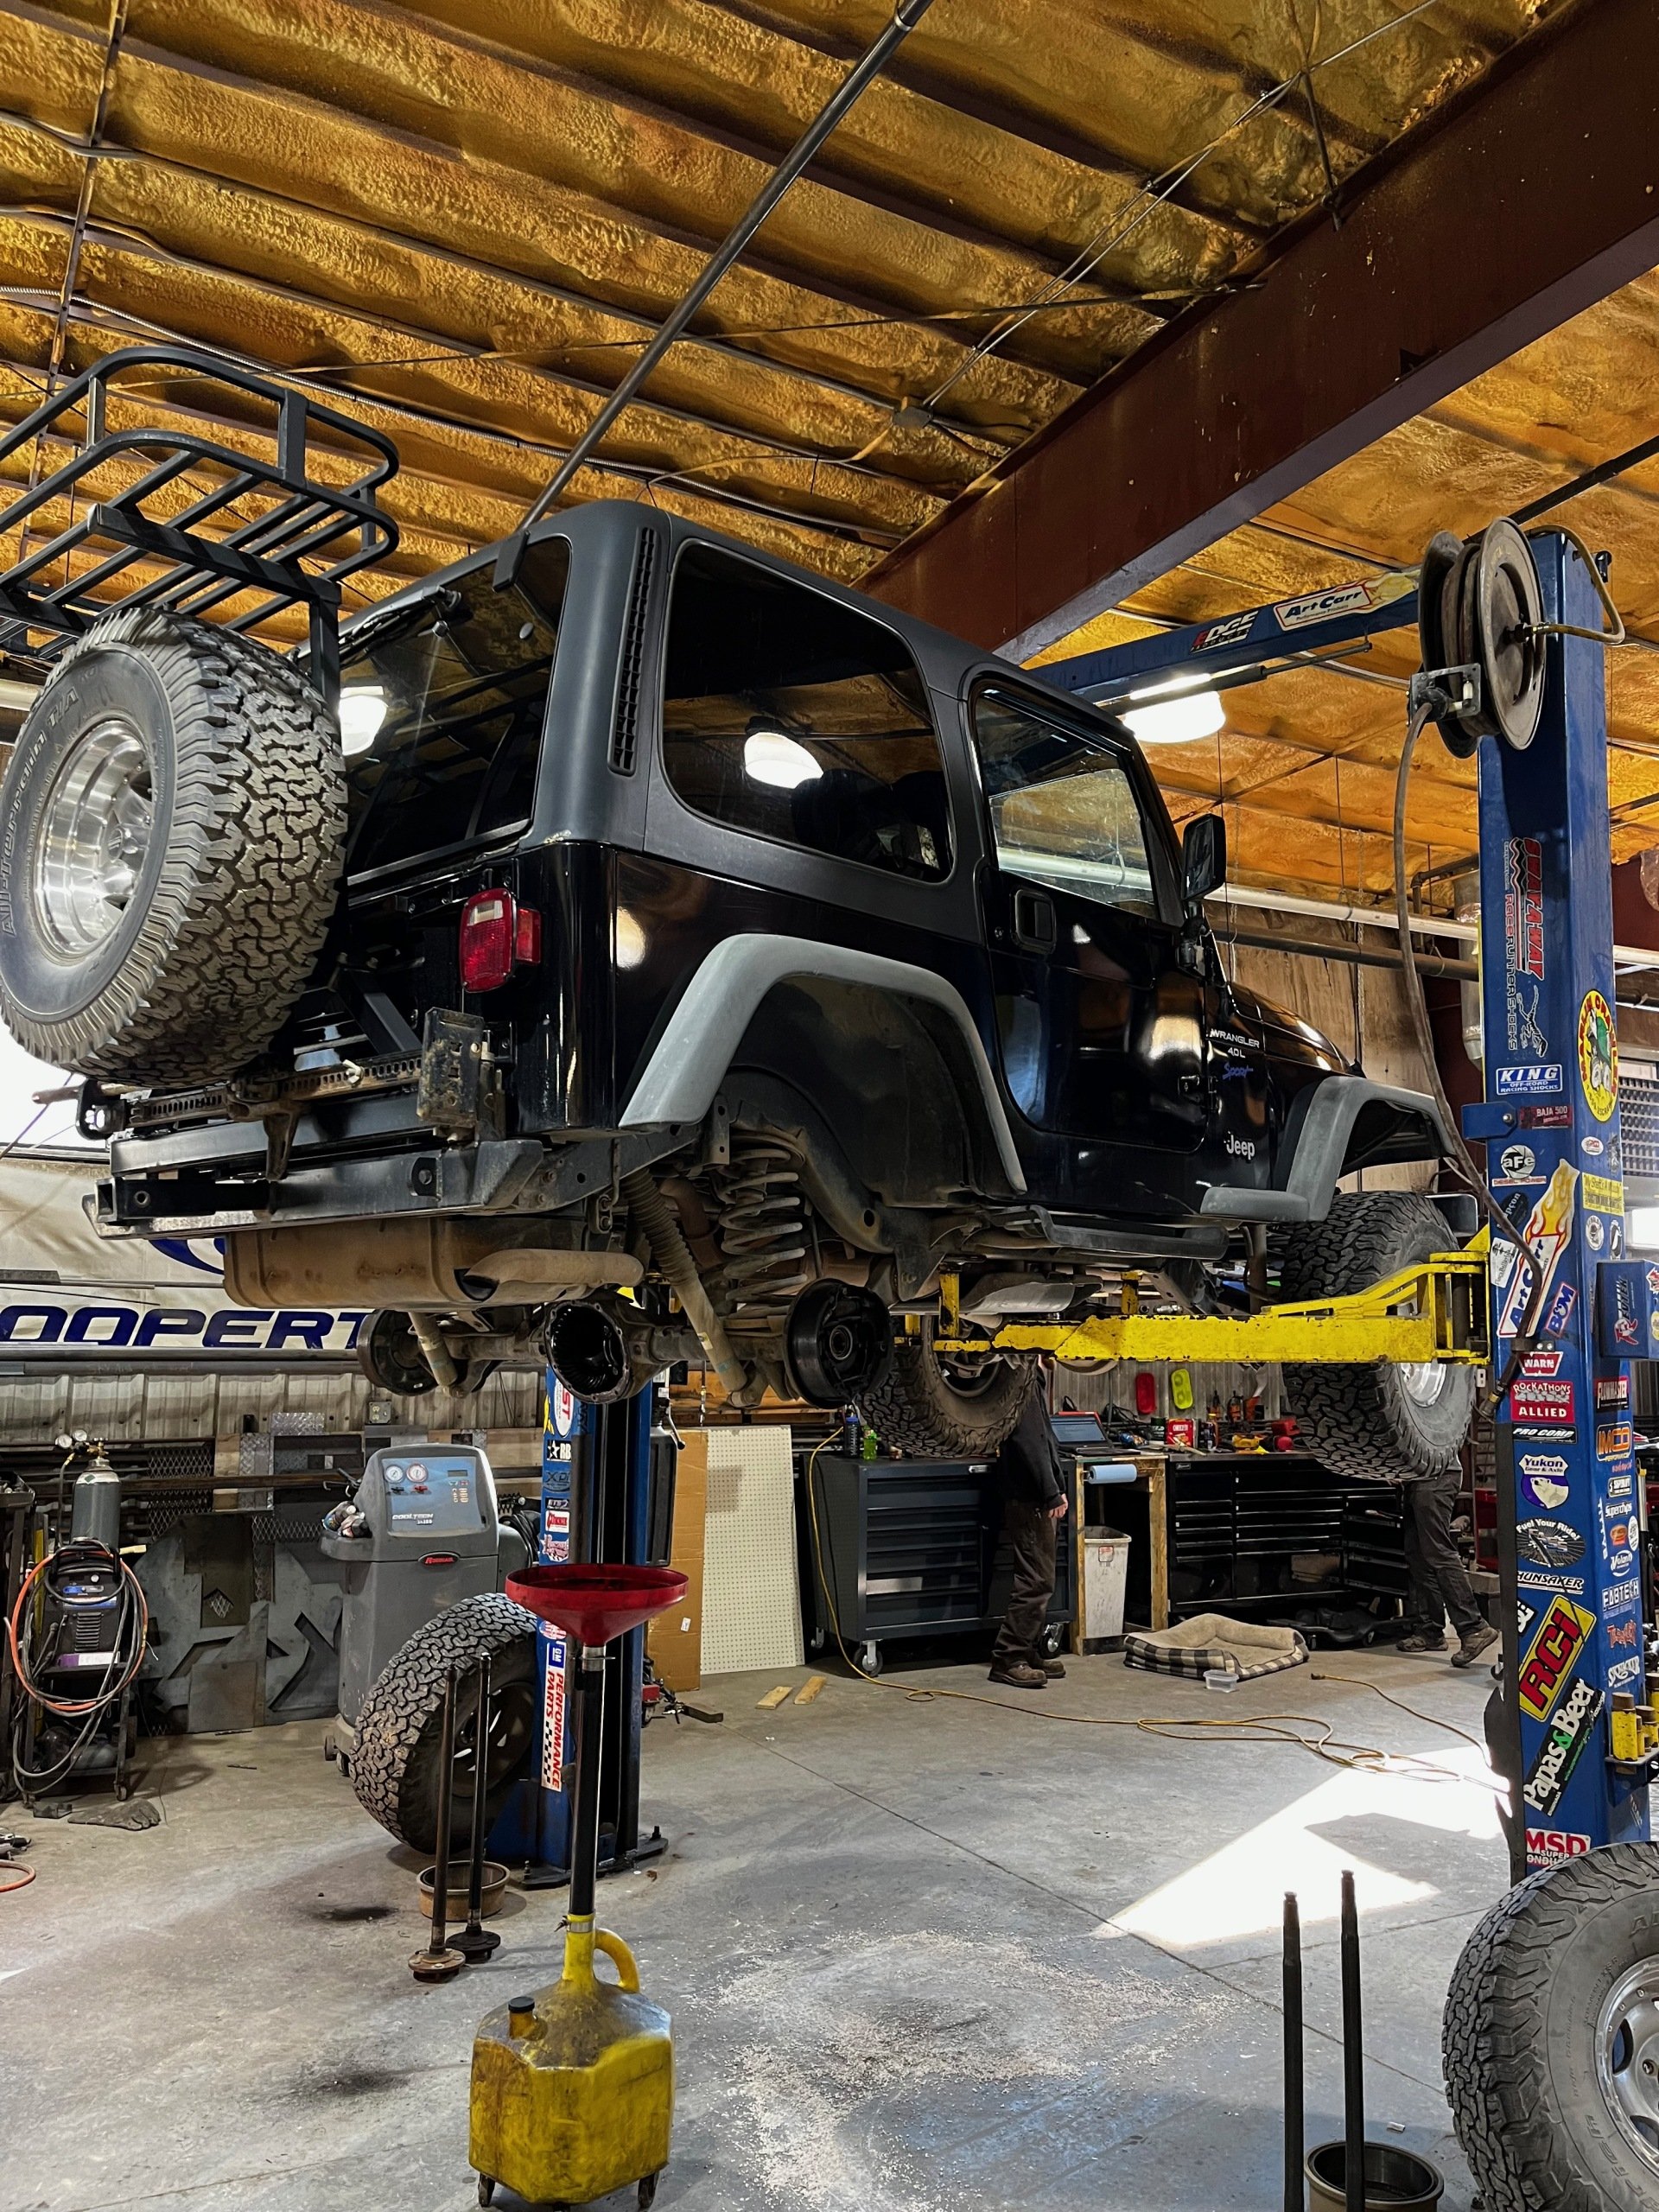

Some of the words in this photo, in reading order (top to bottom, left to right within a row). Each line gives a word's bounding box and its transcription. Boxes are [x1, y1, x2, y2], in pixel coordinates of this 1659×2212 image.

[1210, 1028, 1261, 1048] WRANGLER
[1223, 1062, 1254, 1080] Sport
[1500, 1067, 1559, 1082] KING
[1536, 1107, 1554, 1116] BAJA
[1554, 1106, 1568, 1115] 500
[1226, 1134, 1255, 1160] Jeep
[1503, 1156, 1535, 1168] aFe
[1547, 1285, 1574, 1331] B&M
[1524, 1358, 1554, 1369] WARN
[1512, 1382, 1572, 1395] ROCKATHONS
[1518, 1406, 1567, 1418] ALLIED
[1512, 1427, 1537, 1436] PRO
[1537, 1429, 1575, 1439] COMP
[1524, 1458, 1564, 1468] Yukon
[1516, 1519, 1535, 1533] Fuel
[1535, 1518, 1556, 1528] Your
[1557, 1522, 1581, 1541] Ride!
[554, 1648, 563, 1662] GM
[545, 1670, 556, 1719] PARTS
[552, 1672, 565, 1790] PERFORMANCE
[1523, 1741, 1567, 1812] Papas
[1550, 1678, 1595, 1738] Beer
[1525, 1829, 1587, 1856] MSD
[1541, 1850, 1570, 1859] SUPER
